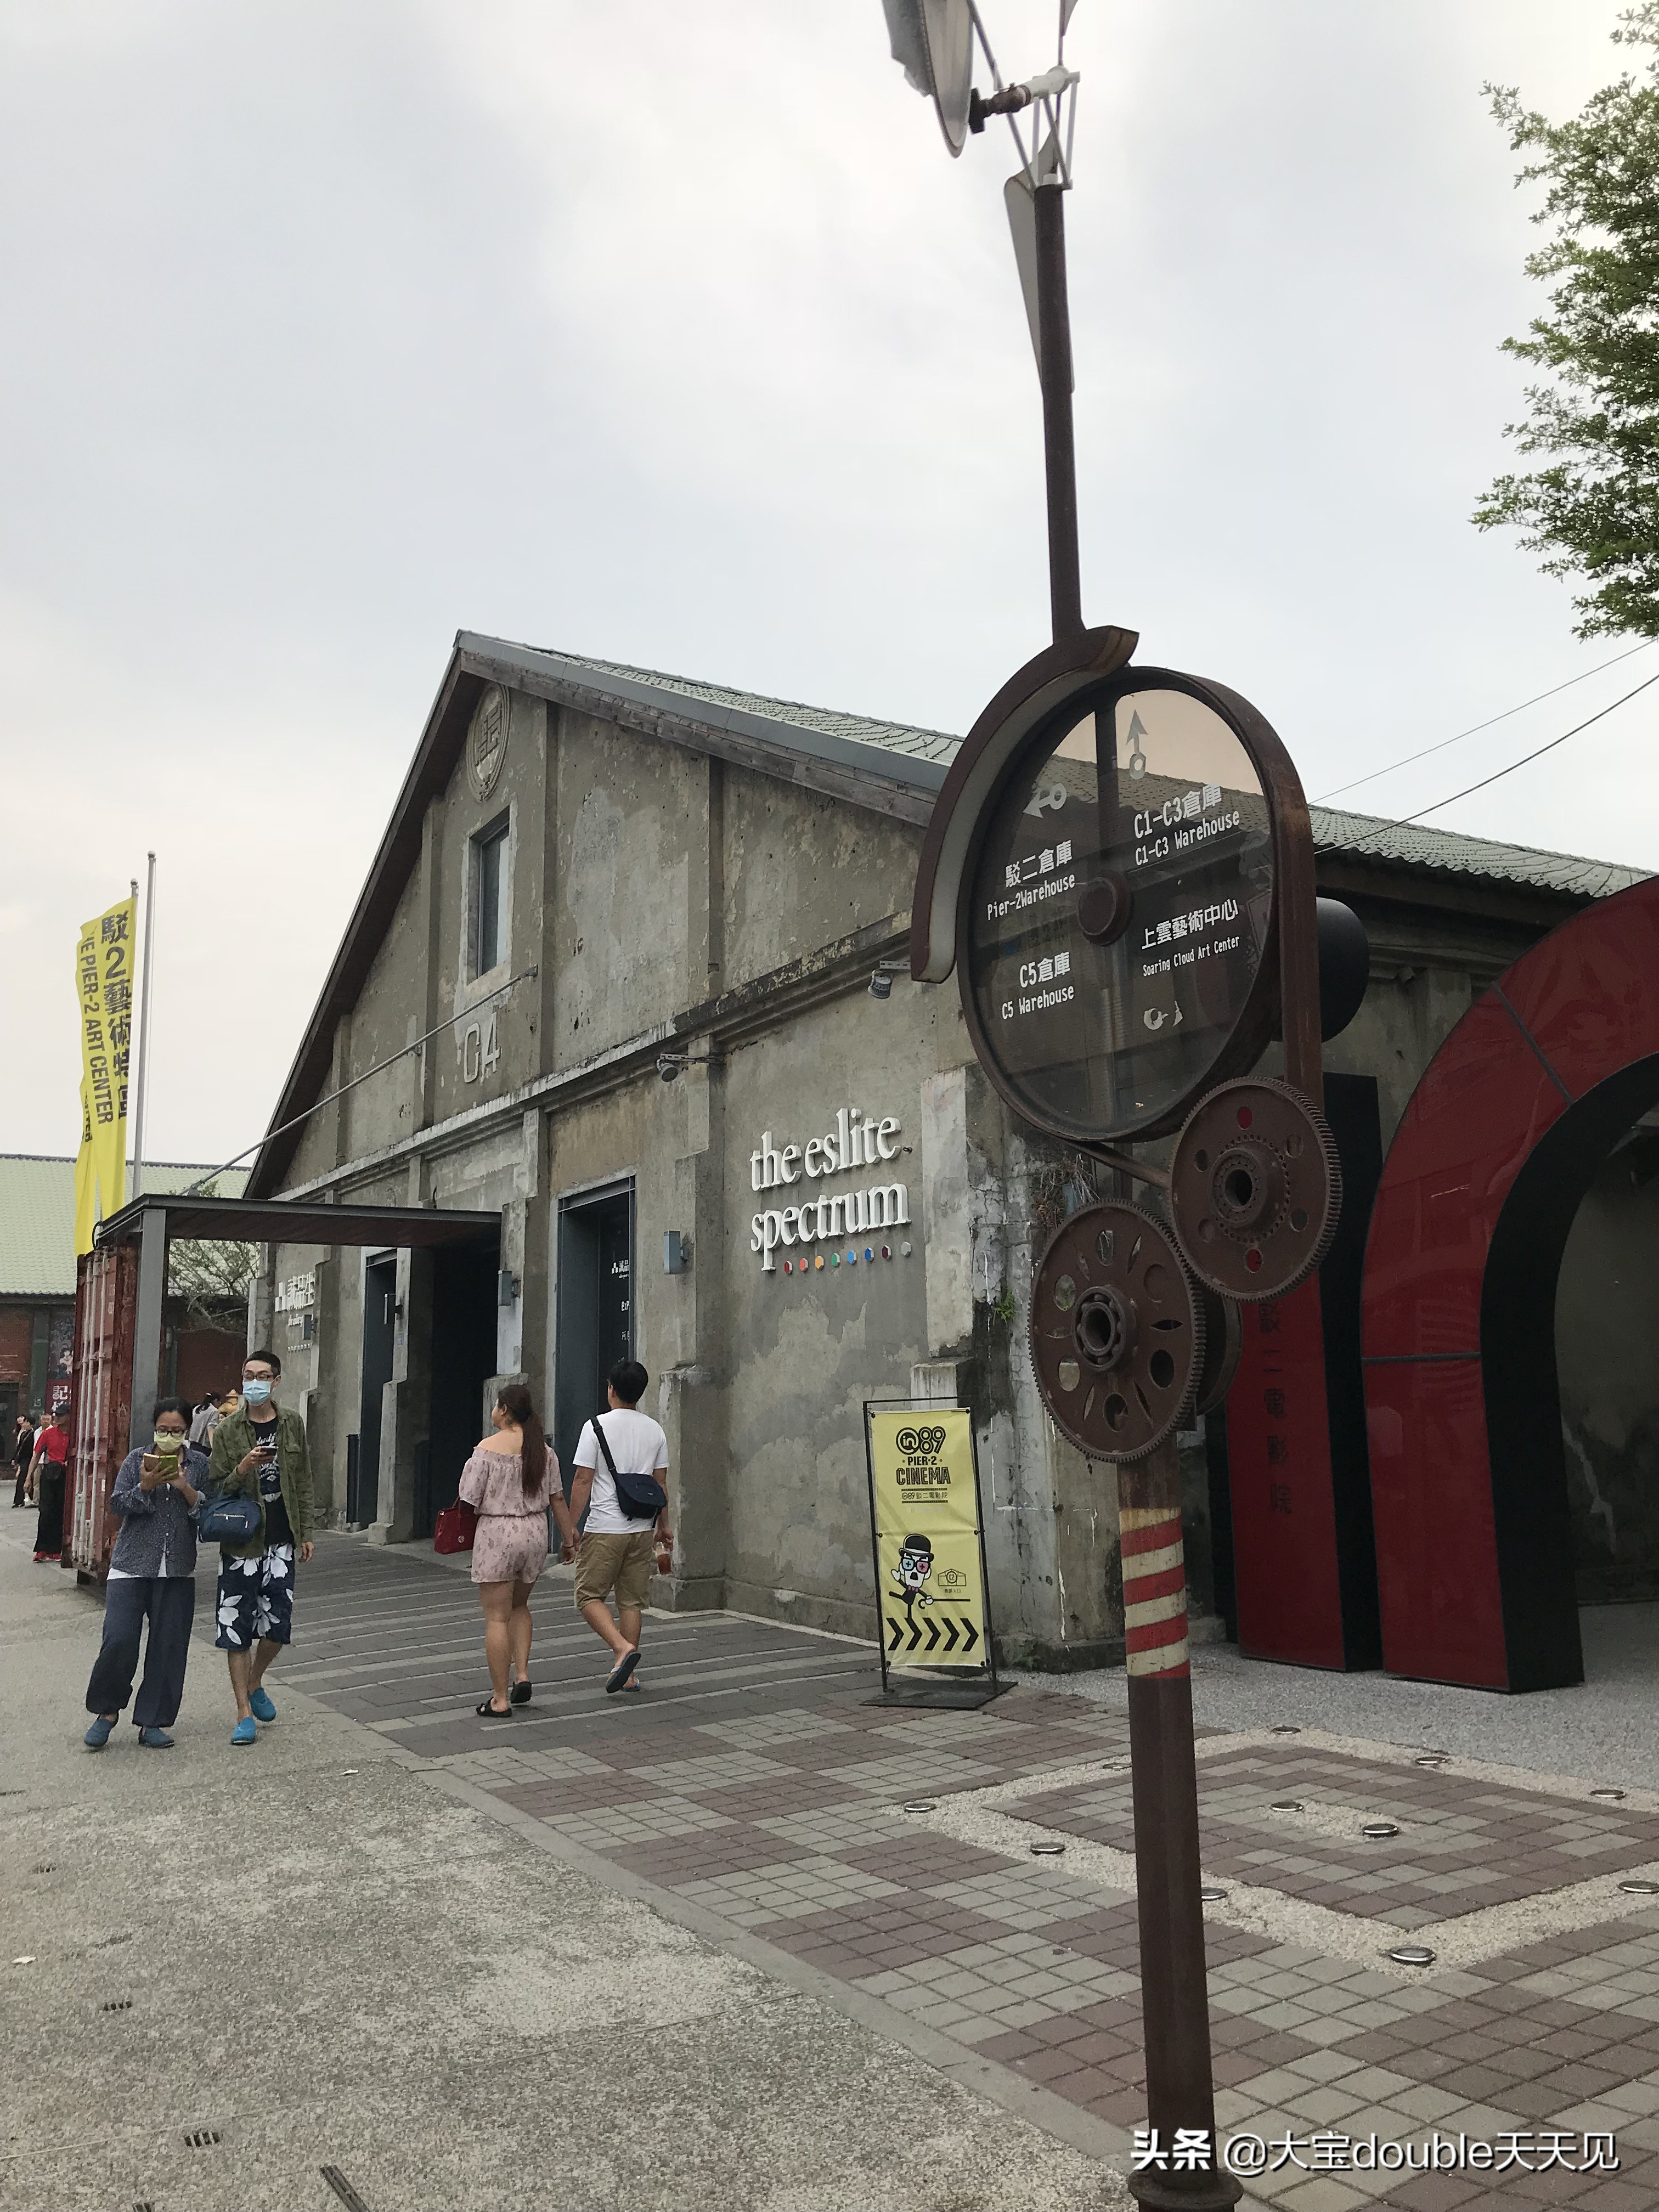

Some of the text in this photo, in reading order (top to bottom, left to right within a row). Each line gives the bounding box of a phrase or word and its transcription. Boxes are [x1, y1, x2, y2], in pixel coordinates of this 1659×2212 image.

[1134, 783, 1222, 839] C1-C3倉庫
[1005, 839, 1073, 888] 駁二倉庫
[1135, 810, 1240, 866] C1-C3 Warehouse
[1141, 899, 1239, 950] 上雲藝術中心
[1019, 951, 1070, 988] C5倉庫
[1143, 936, 1240, 977] Soaring Cloud Art Center
[80, 954, 100, 1014] PIER-2
[1002, 986, 1074, 1020] C5 Warehouse
[85, 1019, 105, 1052] ART
[89, 1056, 114, 1125] CENTER
[749, 1108, 902, 1192] the eslite
[751, 1183, 912, 1271] spectrum
[895, 1466, 951, 1486] CINEMA
